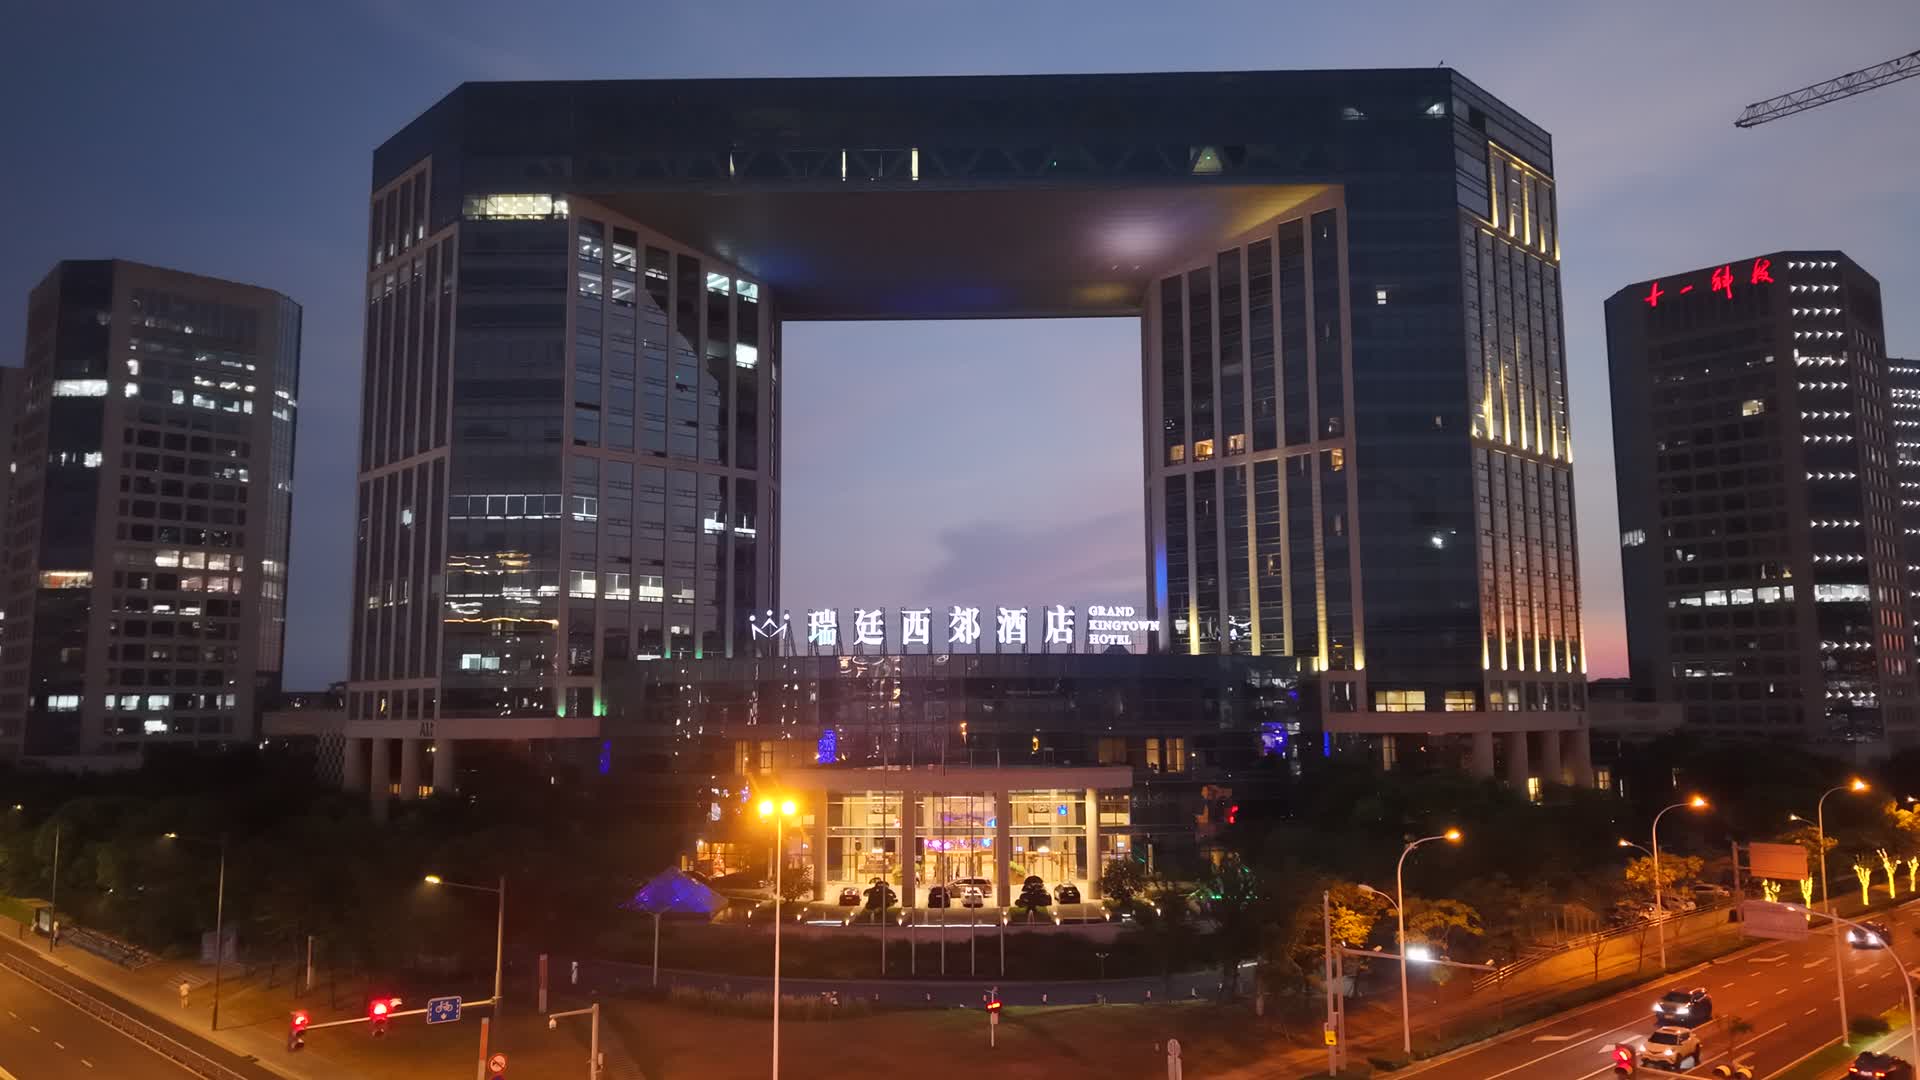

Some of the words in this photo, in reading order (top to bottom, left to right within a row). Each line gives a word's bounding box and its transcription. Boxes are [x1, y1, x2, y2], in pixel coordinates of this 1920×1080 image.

[1088, 605, 1135, 617] GRAND
[807, 605, 1076, 646] 瑞廷西郊酒店
[1088, 619, 1160, 632] KINGTOWN
[1088, 634, 1132, 646] HOTEL
